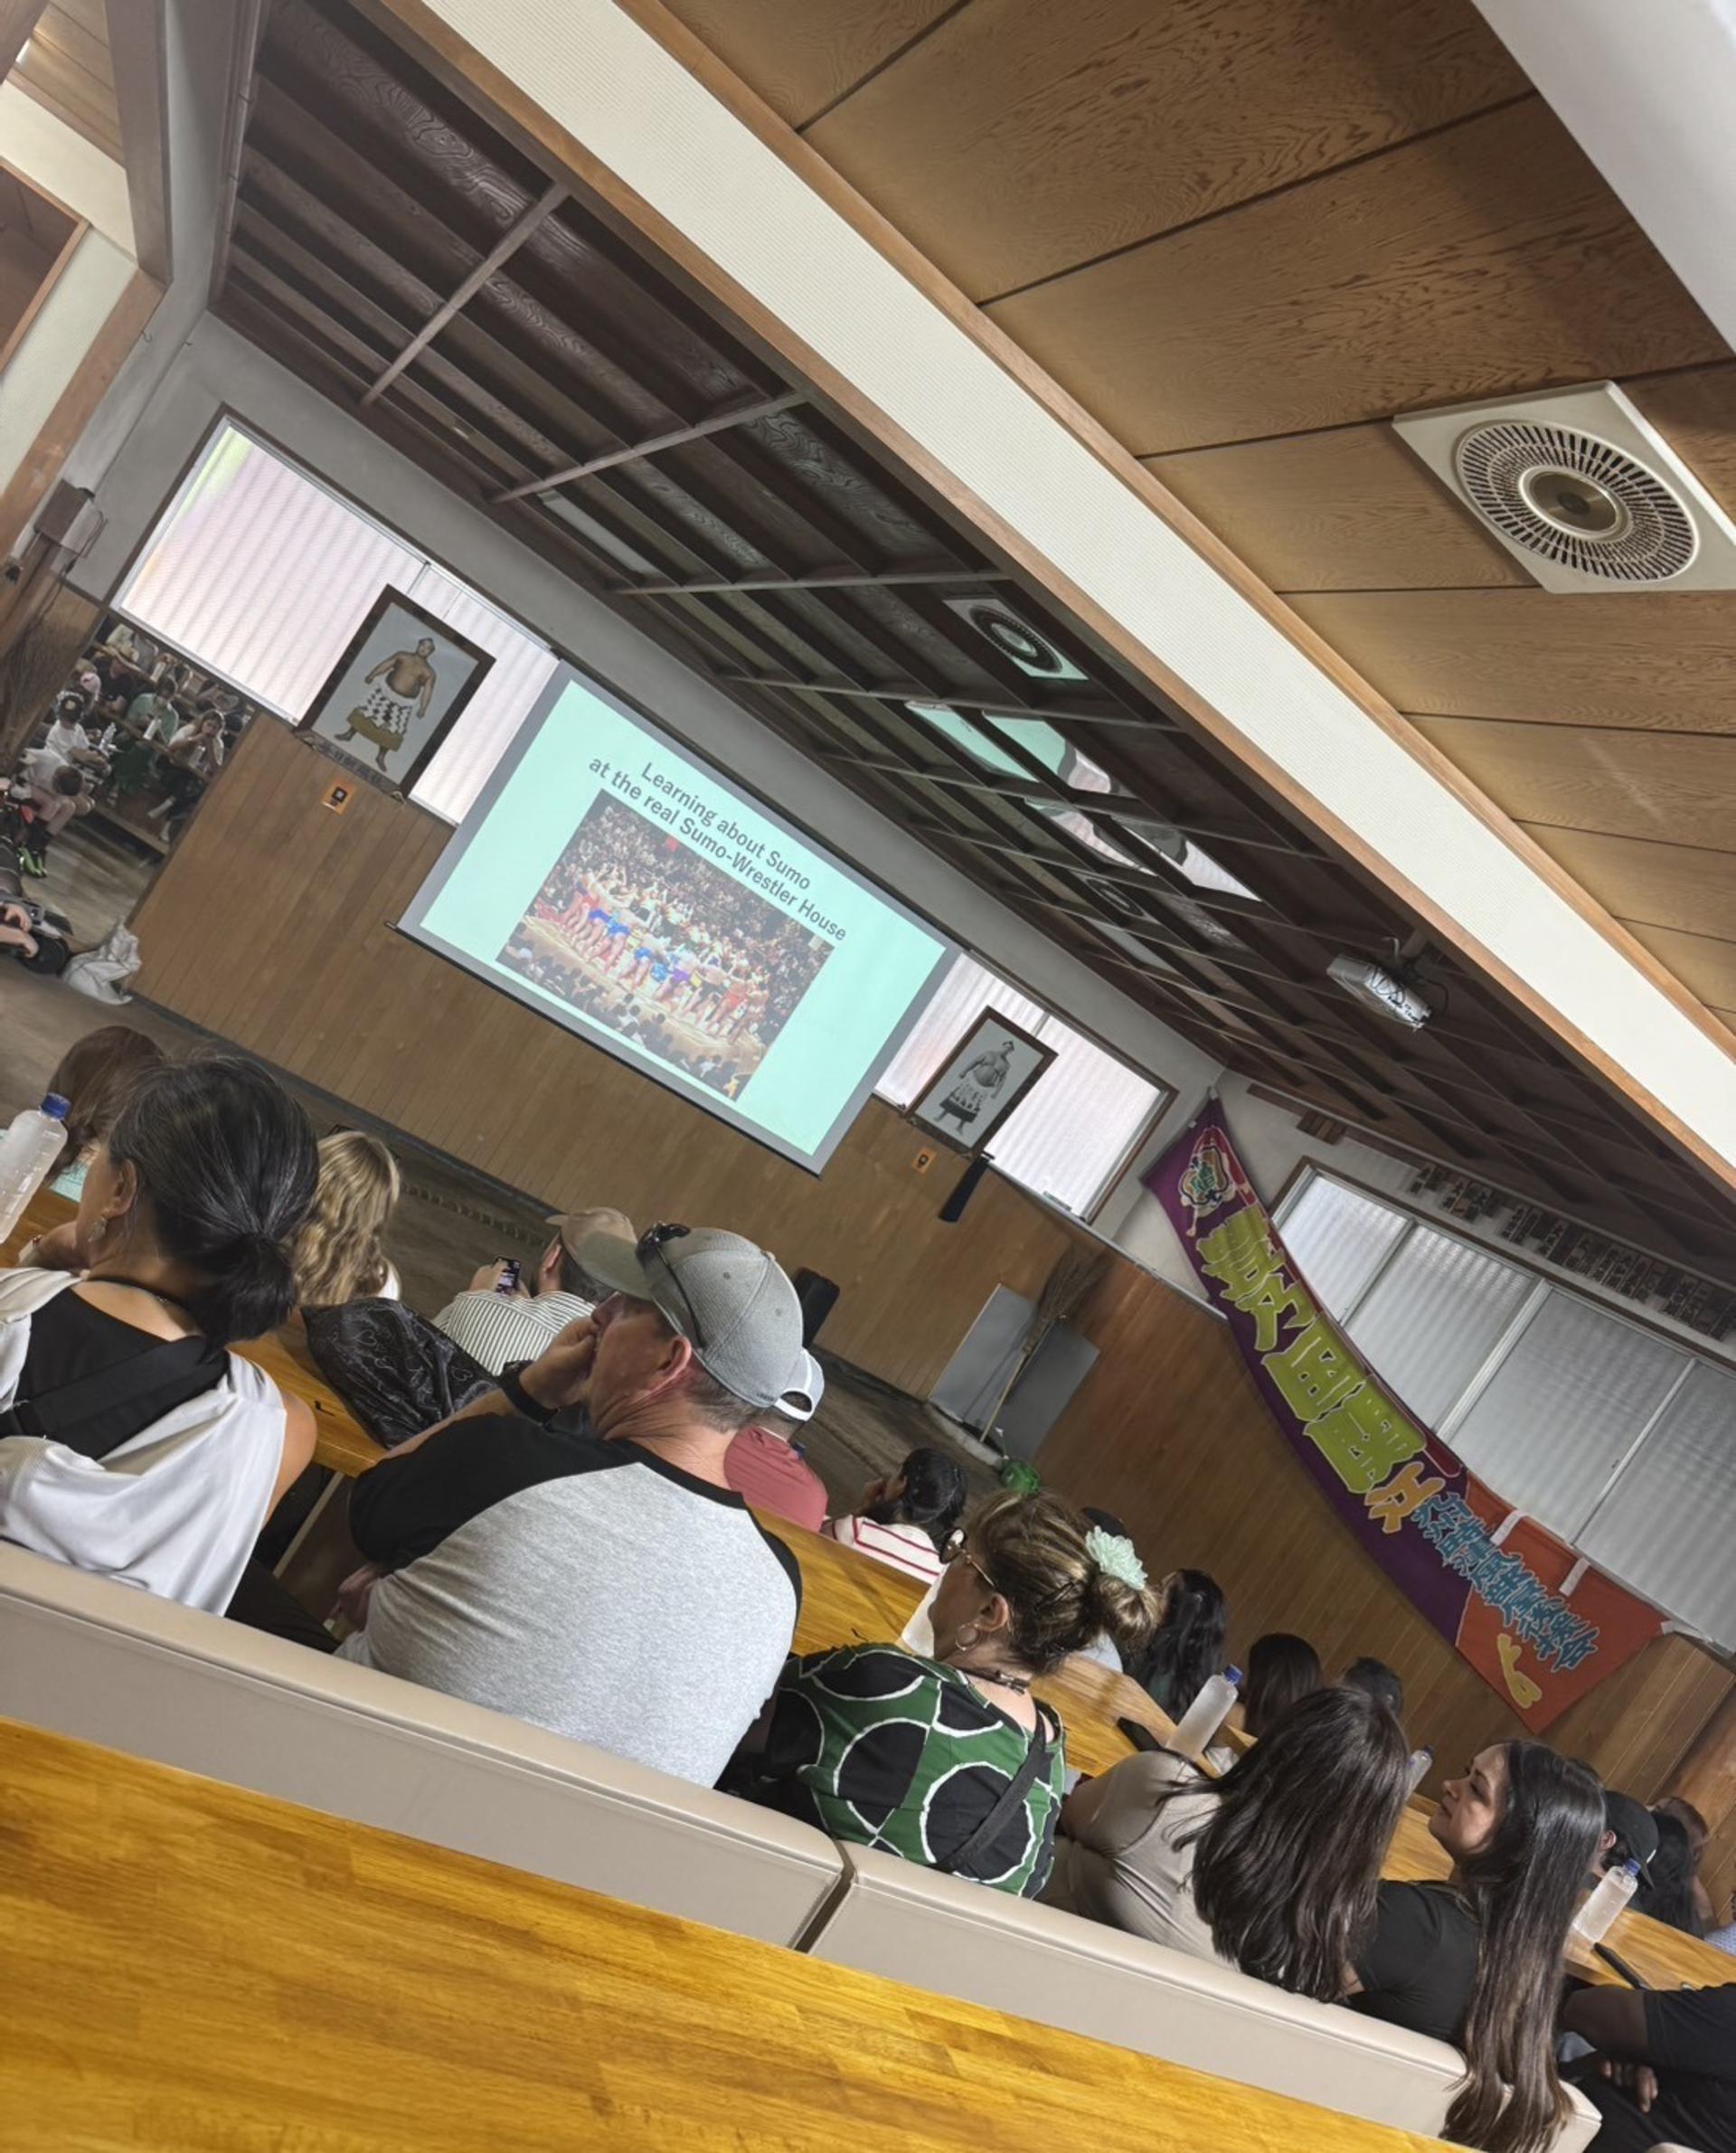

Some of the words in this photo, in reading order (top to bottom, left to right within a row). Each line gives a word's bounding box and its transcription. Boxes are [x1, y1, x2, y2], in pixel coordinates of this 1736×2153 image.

[589, 759, 611, 779] at
[612, 771, 642, 799] the
[644, 797, 680, 825] real
[680, 817, 798, 906] Sumo-Wrestler
[798, 900, 846, 941] House
[642, 762, 717, 827] Learning
[717, 820, 765, 858] about
[767, 851, 811, 891] Sumo
